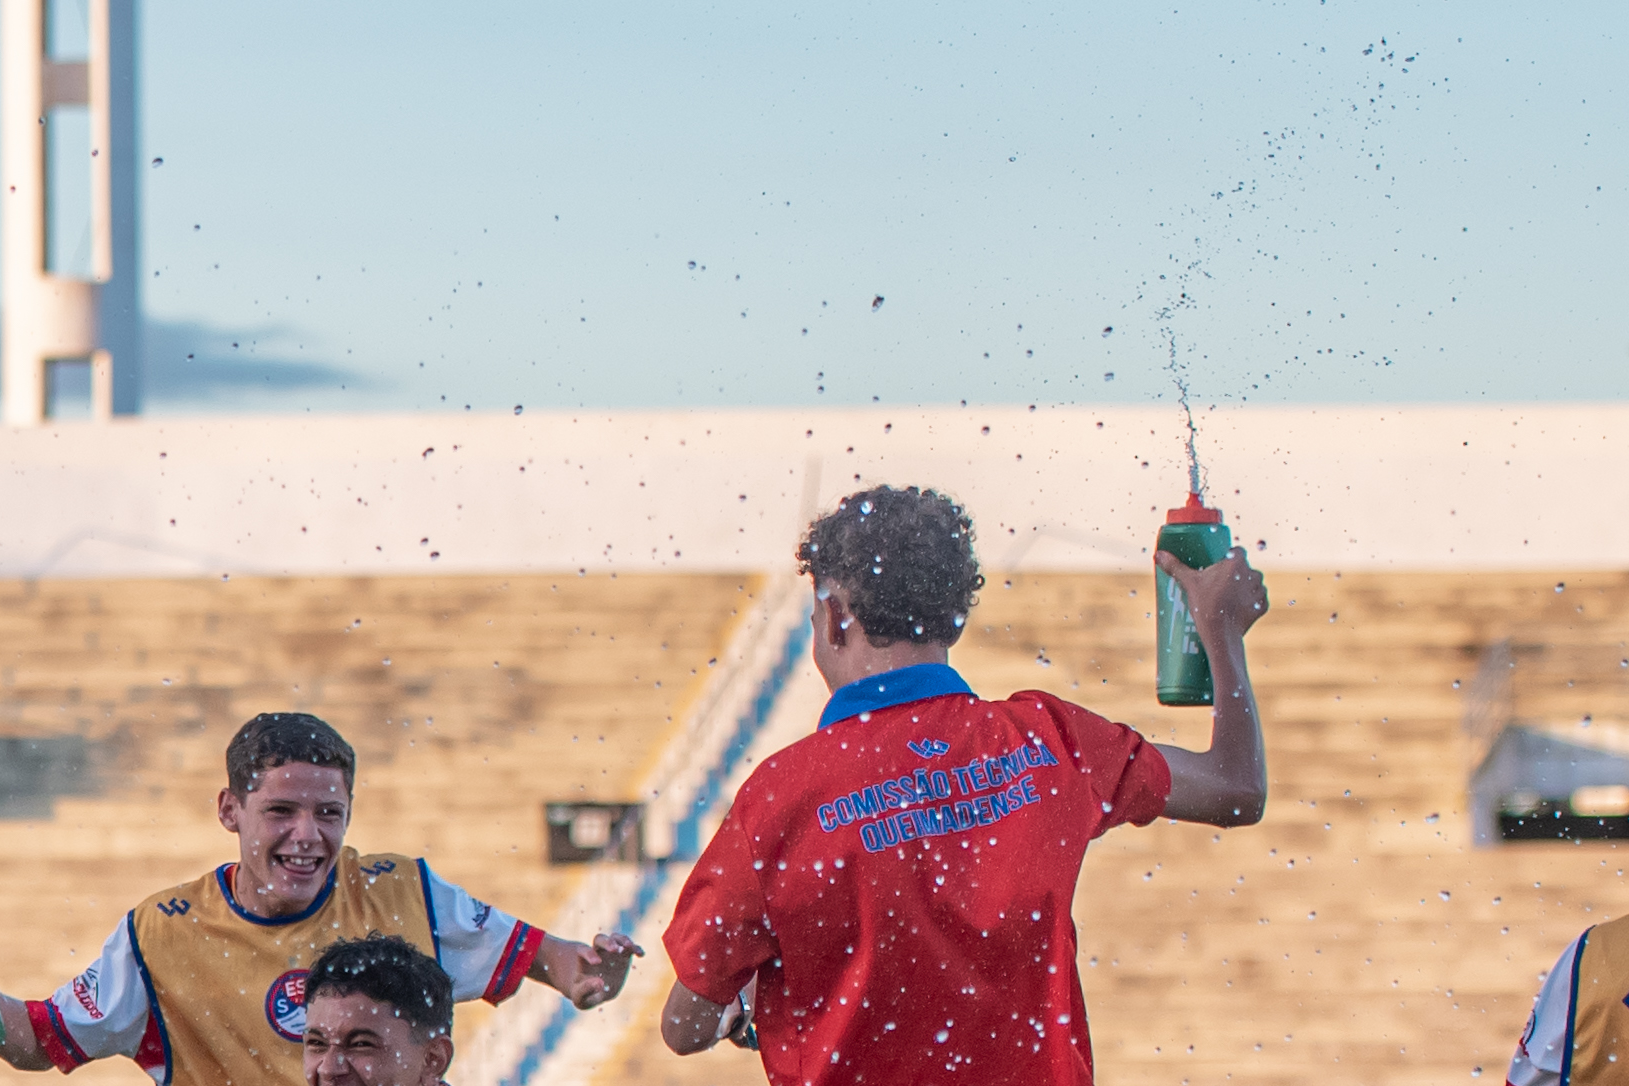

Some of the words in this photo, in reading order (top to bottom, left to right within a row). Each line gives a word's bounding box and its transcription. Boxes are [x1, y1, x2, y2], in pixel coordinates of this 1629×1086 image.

[817, 768, 952, 833] COMISSÃO
[951, 743, 1060, 793] TÉCNICA
[859, 774, 1042, 853] QUEIMADENSE
